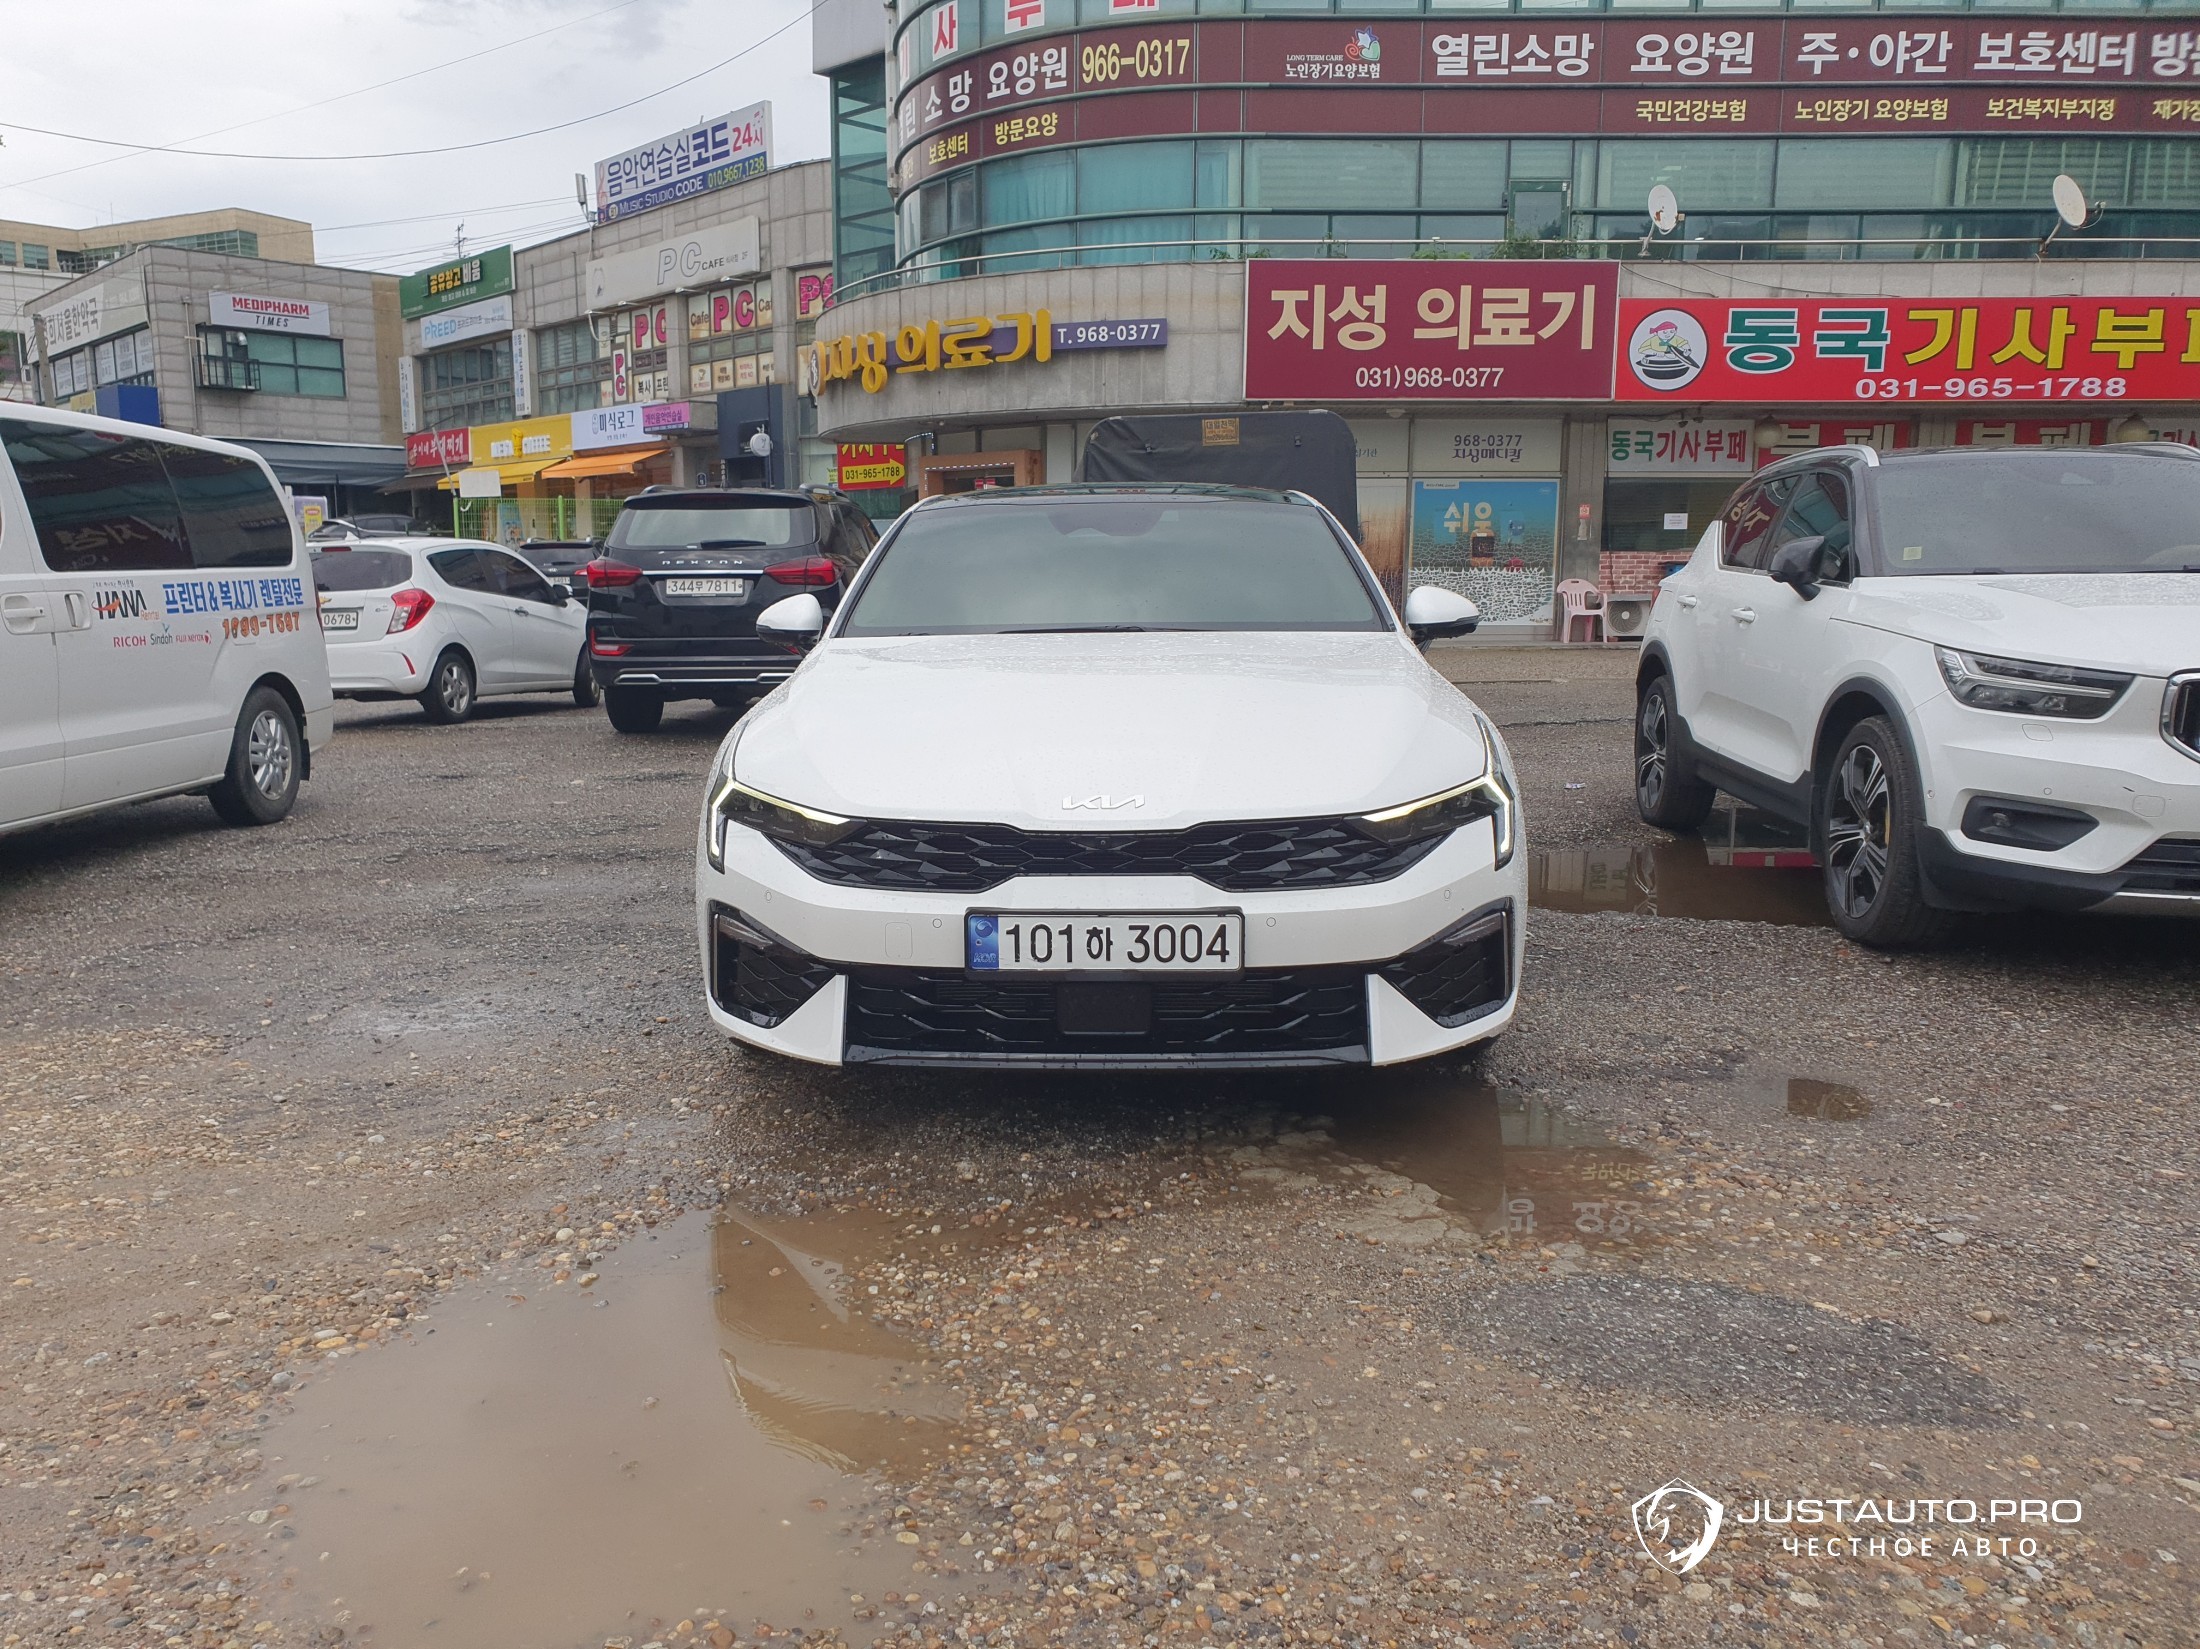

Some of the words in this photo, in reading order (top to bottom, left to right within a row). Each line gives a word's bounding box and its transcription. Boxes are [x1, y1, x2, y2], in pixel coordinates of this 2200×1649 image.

[1286, 54, 1306, 62] LONG
[1306, 54, 1325, 62] TERM
[1325, 54, 1344, 62] CARE
[1432, 33, 1595, 77] 열린소망
[1630, 31, 1755, 77] 요양원
[1974, 31, 2138, 76] 보호센터
[2151, 32, 2200, 77] 방
[986, 46, 1068, 100] 요양원
[1082, 38, 1191, 84] 966-0317
[1285, 63, 1381, 79] 노인장기요양보험
[1635, 99, 1747, 122] 국민건강보험
[1794, 99, 1869, 121] 노인장기
[1873, 98, 1949, 121] 요양보험
[1985, 98, 2116, 121] 보건복지부지정
[732, 122, 763, 153] 24시
[929, 131, 968, 166] 보호센터
[994, 111, 1059, 146] 방문요양
[675, 175, 704, 197] CODE
[657, 241, 702, 286] PC
[701, 257, 725, 271] CAFE
[232, 296, 310, 316] MEDIPHARM
[690, 311, 710, 327] Cafe
[713, 290, 754, 333] PC
[1267, 284, 1388, 351] 지성
[1413, 284, 1597, 351] 의료기
[255, 315, 289, 328] TIMES
[896, 308, 1051, 374] 의료기
[1076, 323, 1161, 343] 968-0377
[1354, 365, 1505, 390] 031)968-0377
[1855, 376, 2127, 399] 031-965-1788
[599, 409, 635, 433] 미식로그
[1453, 434, 1523, 448] 968-0377
[845, 466, 901, 480] 031-965-1788
[706, 580, 737, 593] 7811
[95, 590, 147, 620] HANA
[323, 613, 351, 626] 0678
[113, 635, 147, 648] RICOH
[150, 633, 173, 647] Sindoh
[1005, 923, 1114, 963] 101하
[1126, 923, 1230, 963] 3004
